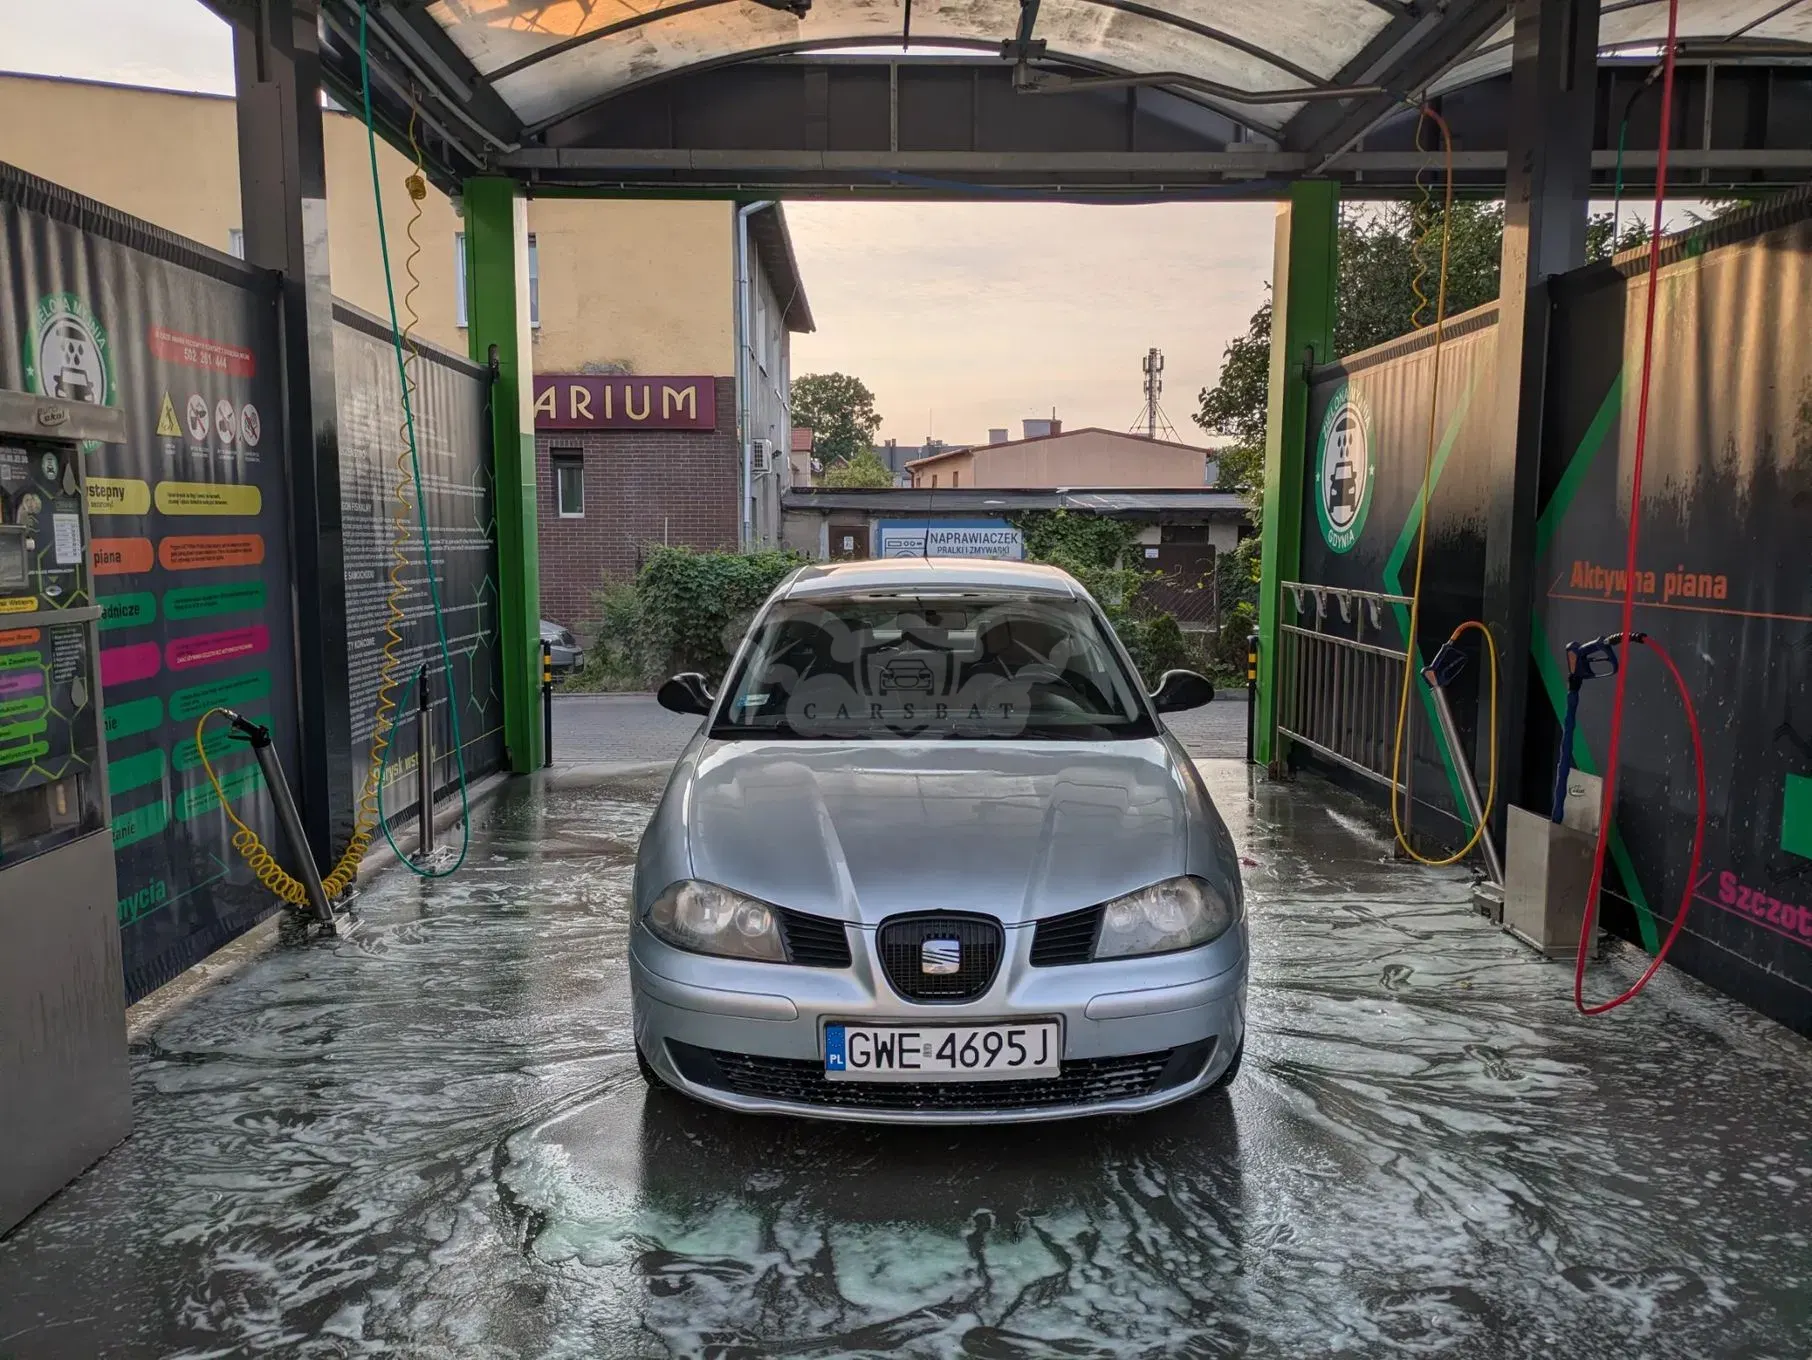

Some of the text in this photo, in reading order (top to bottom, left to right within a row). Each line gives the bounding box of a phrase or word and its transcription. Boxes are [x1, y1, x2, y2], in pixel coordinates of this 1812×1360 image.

[534, 385, 697, 421] ARIUM
[930, 532, 1018, 544] NAPRAWIACZEK
[1327, 529, 1355, 549] GDYNIA
[93, 549, 122, 568] piana
[937, 546, 964, 554] PRALKI
[1570, 560, 1728, 603] Aktywna piana
[848, 1029, 1048, 1069] GWE 4695J
[829, 1054, 844, 1065] PL
